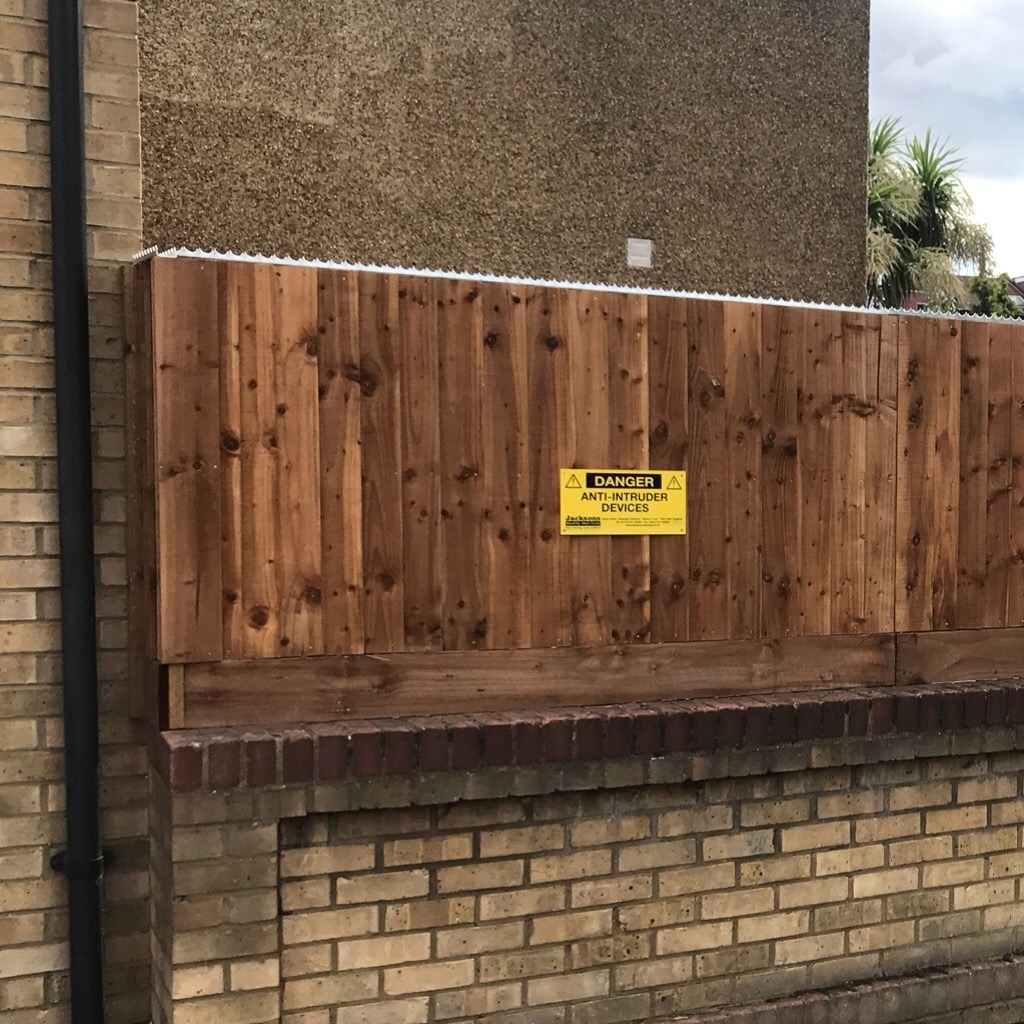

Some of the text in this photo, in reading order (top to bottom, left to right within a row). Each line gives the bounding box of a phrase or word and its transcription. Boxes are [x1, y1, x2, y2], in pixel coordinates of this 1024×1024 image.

[594, 475, 655, 487] DANGER
[581, 492, 668, 502] ANTI-INTRUDER
[602, 503, 649, 512] DEVICES
